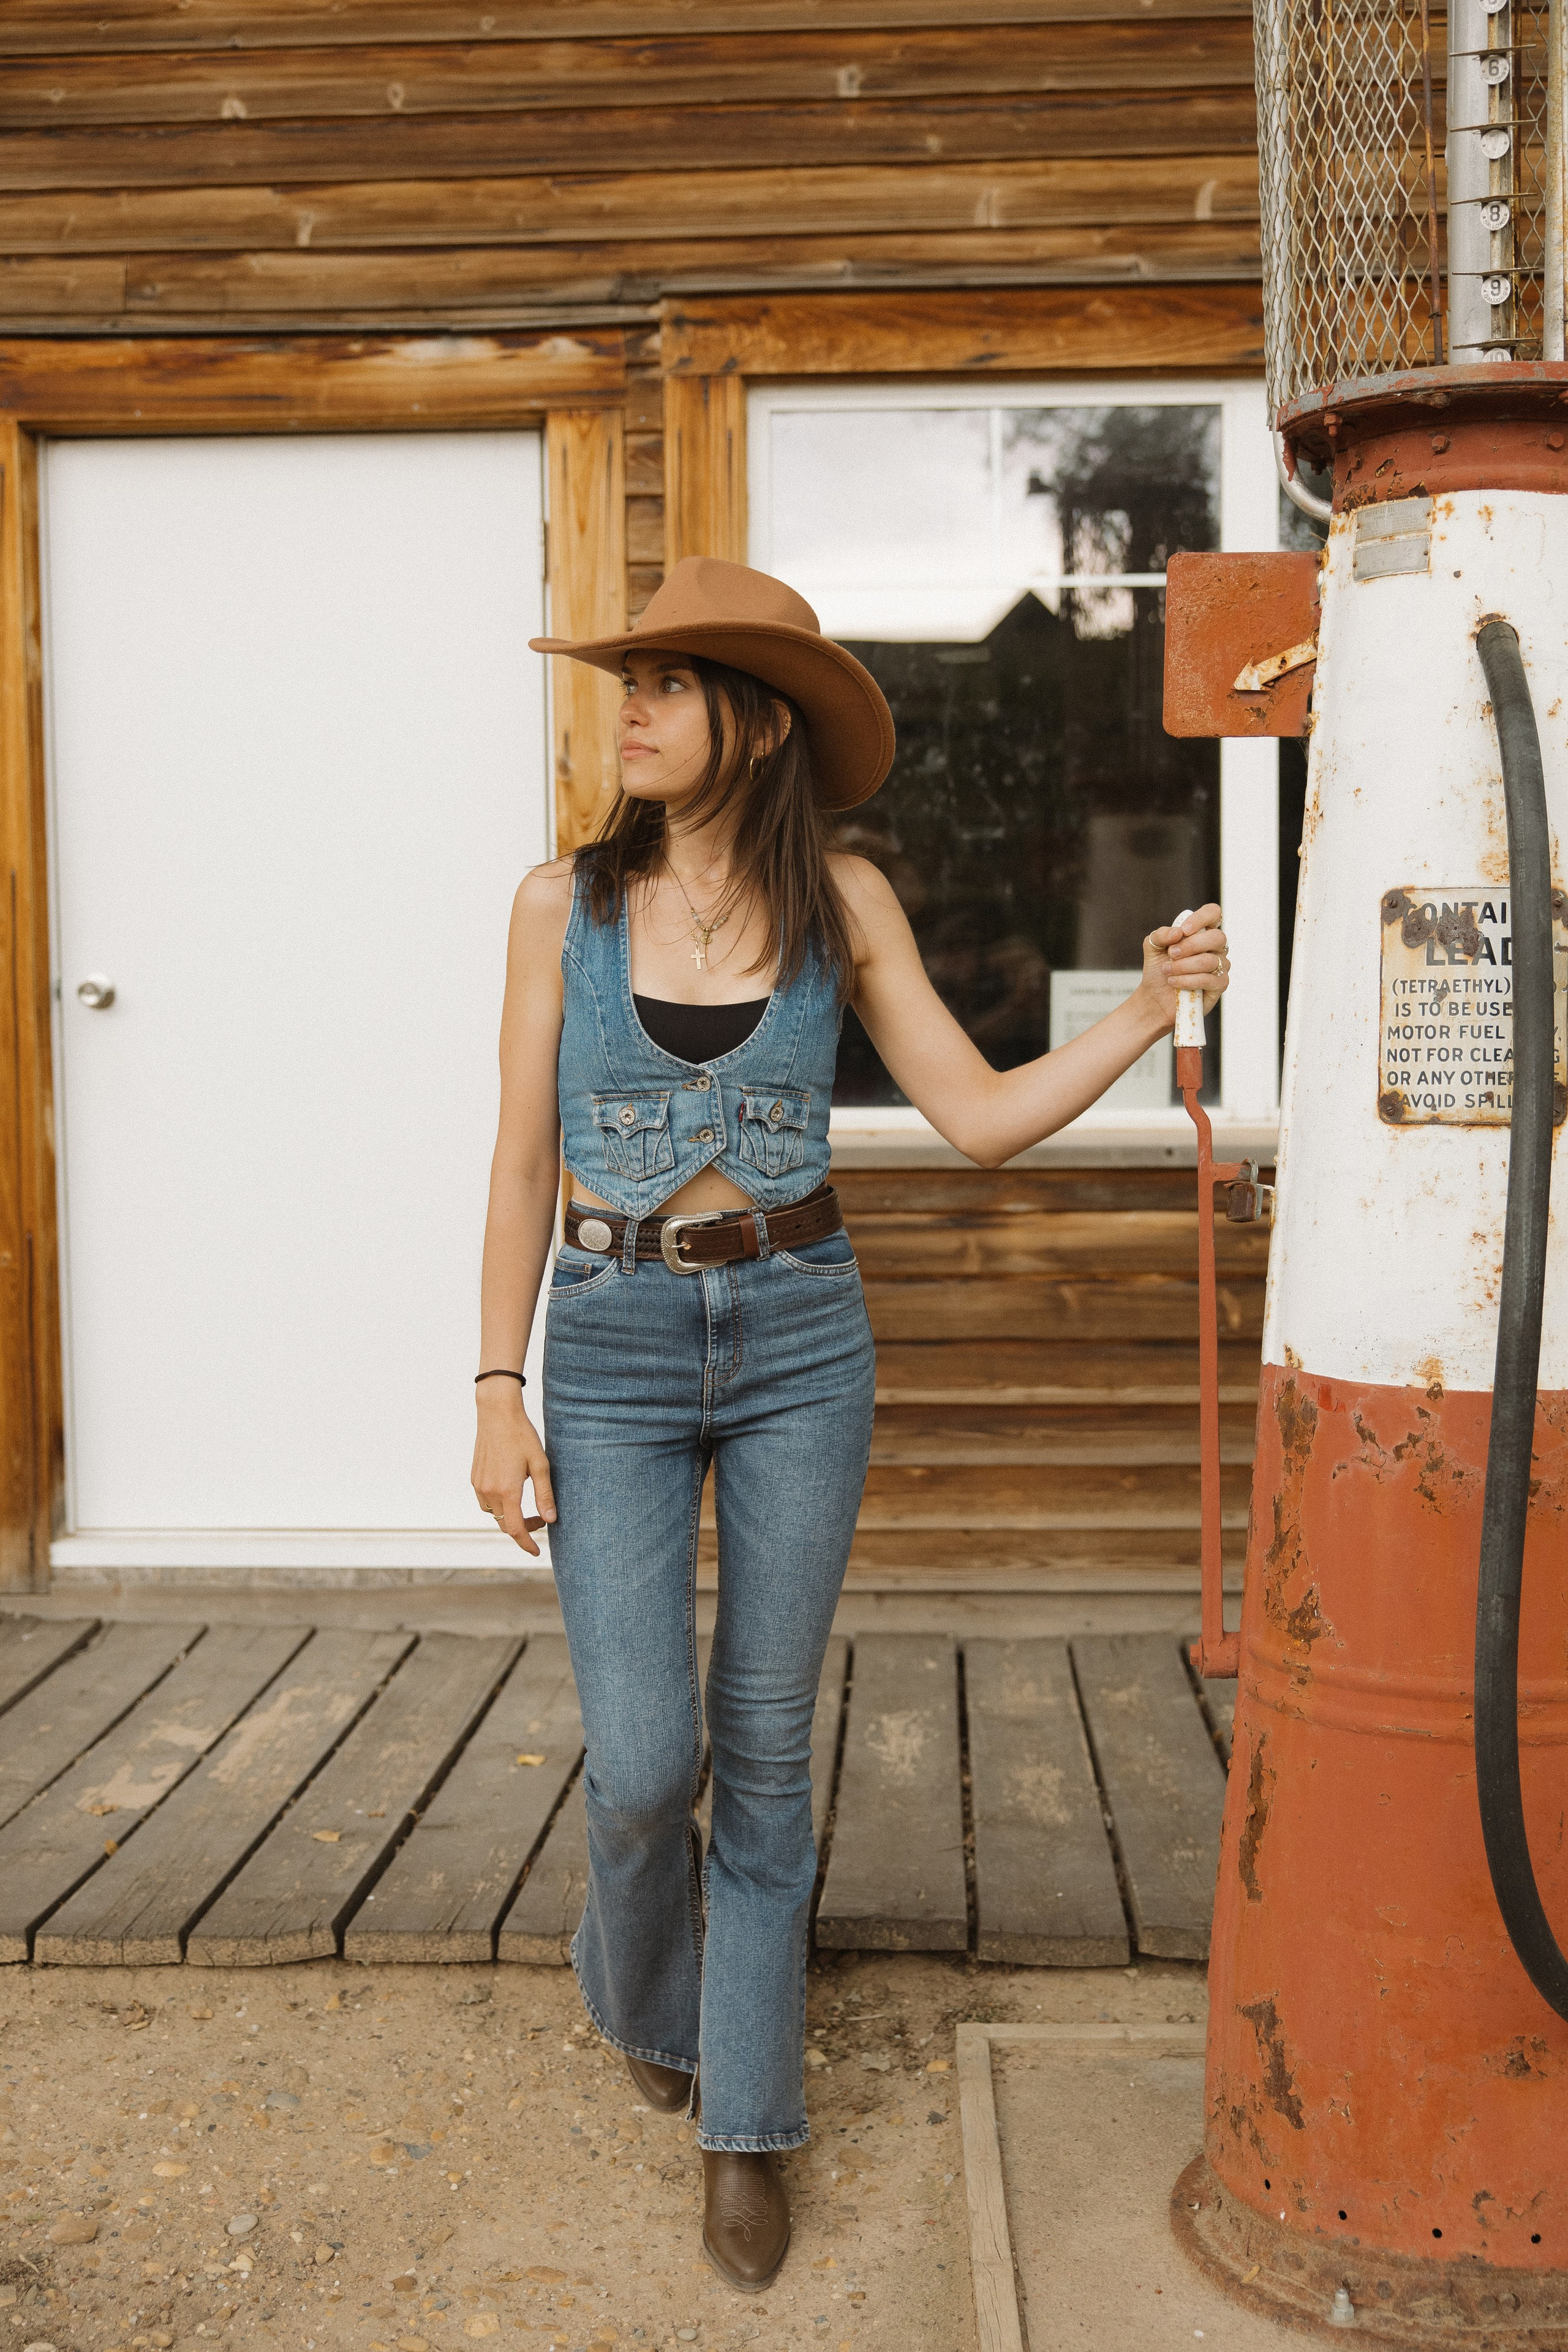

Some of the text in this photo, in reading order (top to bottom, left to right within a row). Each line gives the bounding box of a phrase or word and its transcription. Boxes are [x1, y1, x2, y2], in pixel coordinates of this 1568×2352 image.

[1488, 59, 1499, 76] 6
[1490, 205, 1500, 222] 8
[1490, 279, 1501, 296] 9
[1403, 902, 1506, 924] CONTAI
[1392, 976, 1510, 997] (TETRAETHYL)
[1395, 1001, 1513, 1017] IS TO BE USE
[1387, 1025, 1505, 1039] MOTOR FUEL
[1387, 1047, 1421, 1063] NOT
[1427, 1047, 1463, 1062] FOR
[1387, 1071, 1411, 1086] OR
[1417, 1071, 1455, 1085] ANY
[1401, 1093, 1512, 1109] AVOID SPILL
